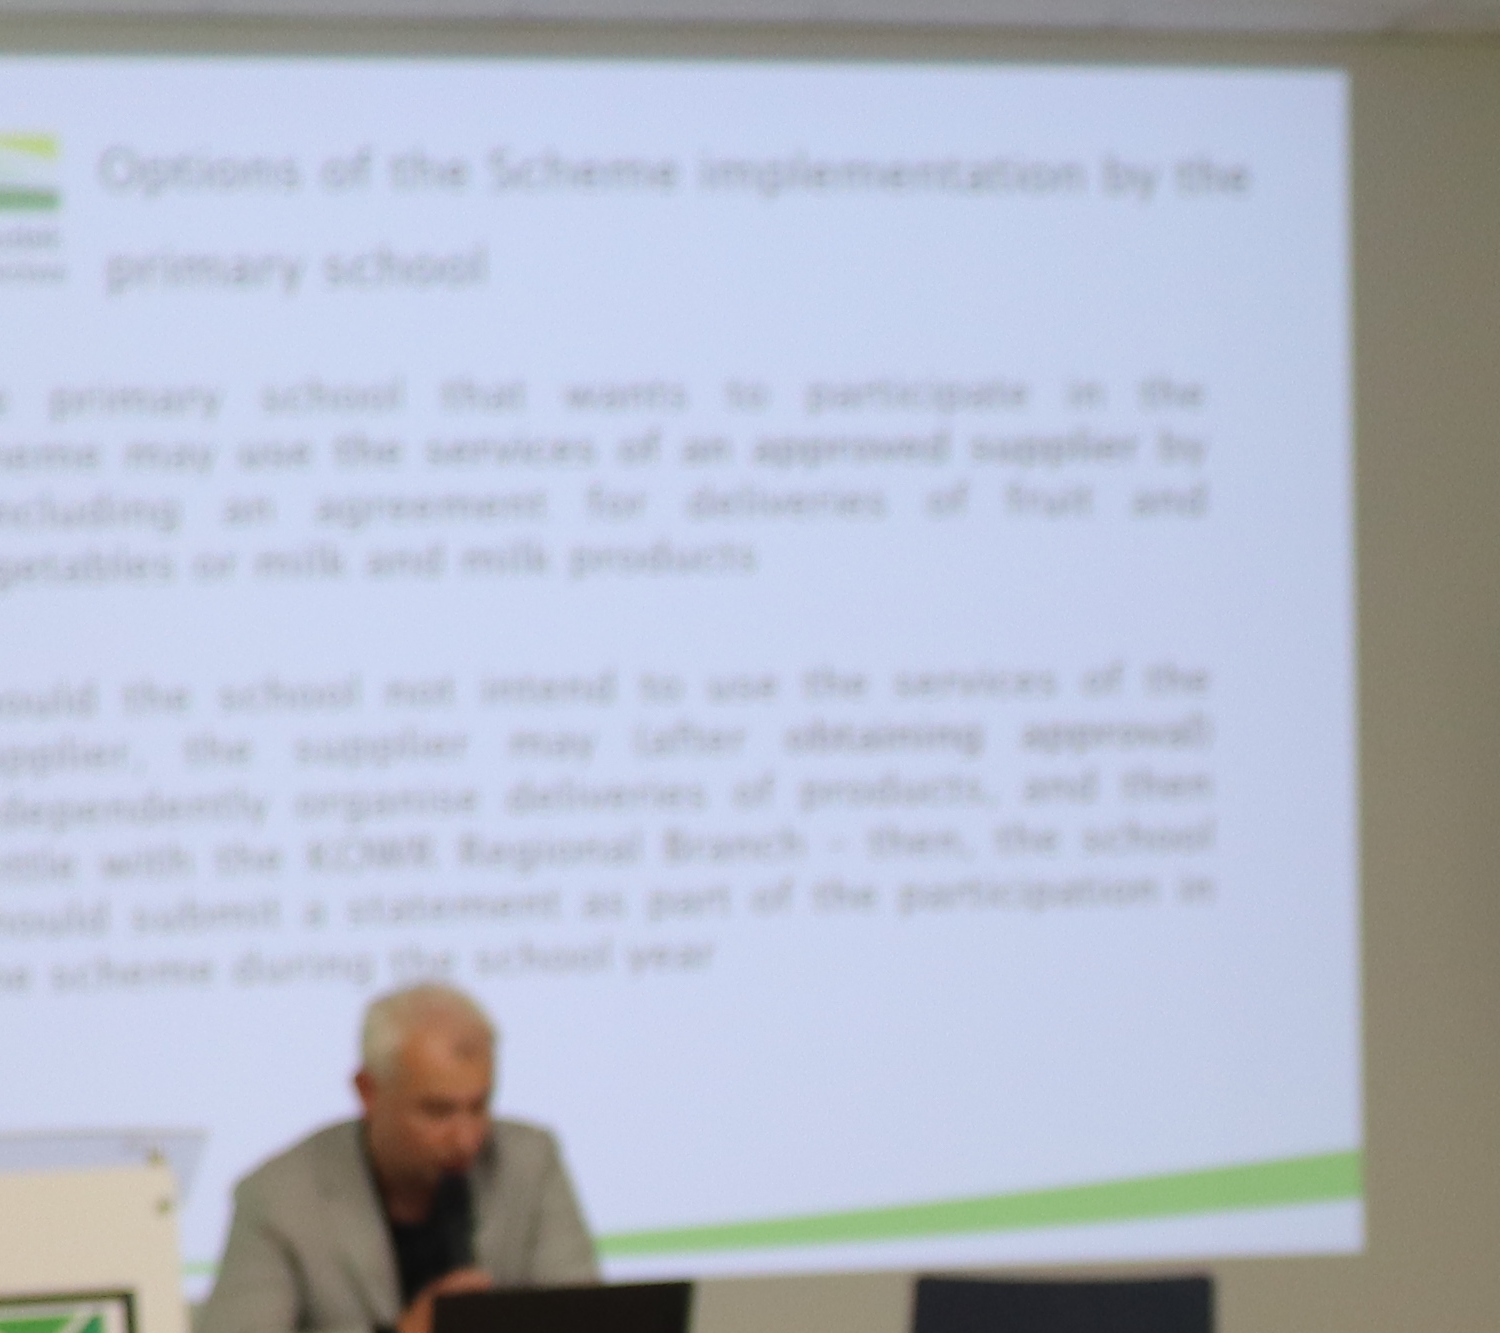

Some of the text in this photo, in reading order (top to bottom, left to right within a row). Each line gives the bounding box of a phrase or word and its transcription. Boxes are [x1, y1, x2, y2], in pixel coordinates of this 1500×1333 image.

[100, 145, 1251, 203] Options of the Scheme implementation by the
[106, 248, 303, 294] primary
[323, 242, 488, 287] school
